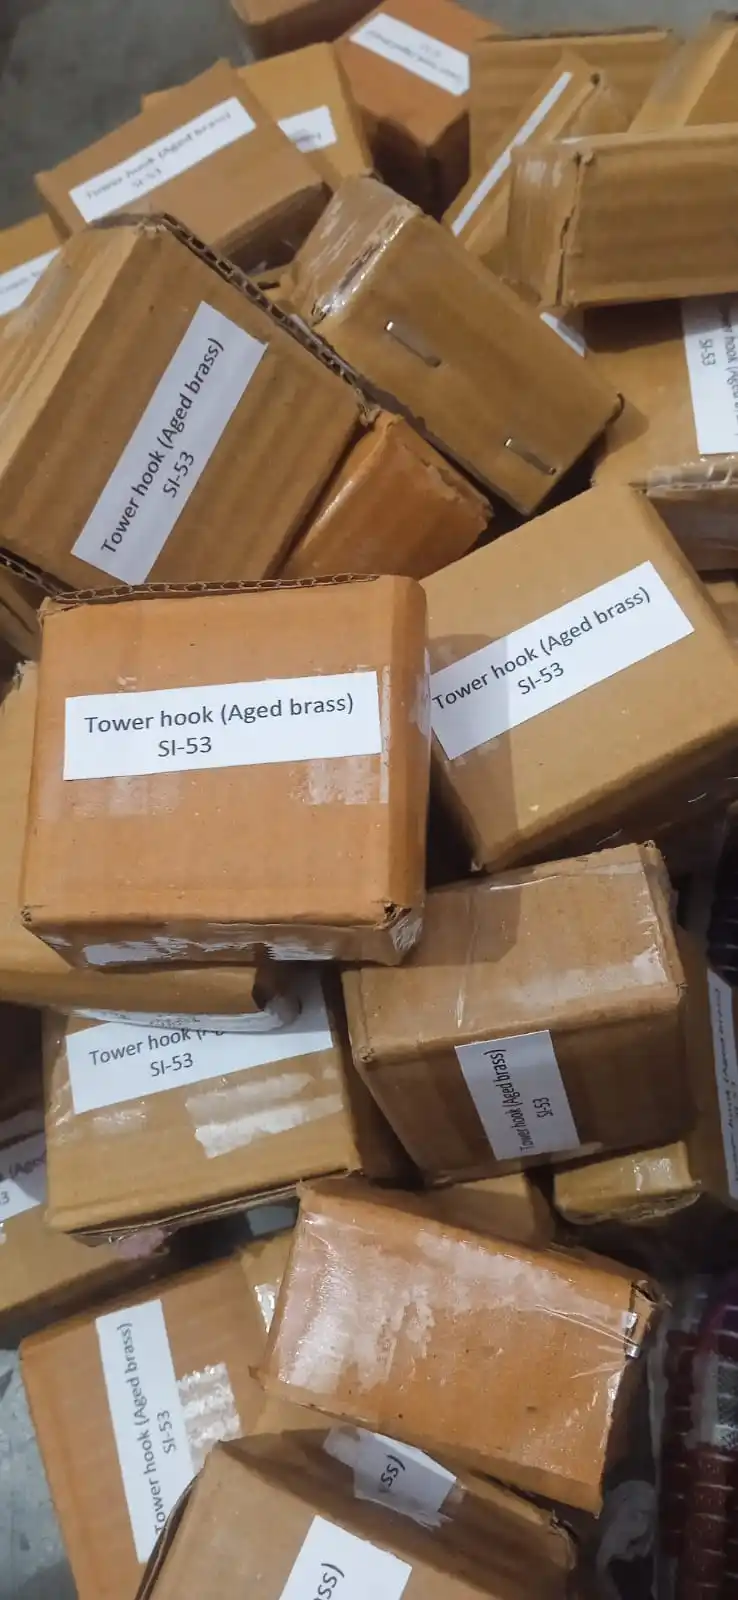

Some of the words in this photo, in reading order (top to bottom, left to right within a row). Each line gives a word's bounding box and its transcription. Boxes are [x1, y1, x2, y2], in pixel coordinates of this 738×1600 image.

[699, 338, 717, 367] SI-53
[100, 498, 141, 553] Tower
[132, 450, 166, 498] hook
[156, 394, 194, 451] (Aged
[184, 337, 225, 395] brass)
[163, 451, 195, 499] SI-53
[431, 673, 489, 711] Tower
[490, 646, 539, 681] hook
[540, 615, 593, 656] (Aged
[593, 586, 651, 625] brass)
[517, 661, 565, 696] SI-53
[84, 714, 155, 734] Tower
[160, 705, 214, 728] hook
[221, 699, 283, 726] (Aged
[289, 692, 354, 716] brass)
[157, 736, 213, 758] SI-53
[89, 1040, 145, 1067] Tower
[147, 1027, 191, 1051] hook
[150, 1052, 194, 1078] SI-53
[483, 1049, 511, 1082] brass)
[496, 1082, 524, 1108] (Aged
[532, 1096, 554, 1119] SI-53
[505, 1107, 527, 1129] hook
[515, 1128, 536, 1152] Tower
[116, 1322, 138, 1374] brass)
[126, 1378, 151, 1425] (Aged
[156, 1409, 177, 1455] SI-53
[137, 1431, 157, 1475] hook
[313, 1562, 345, 1600] ss)
